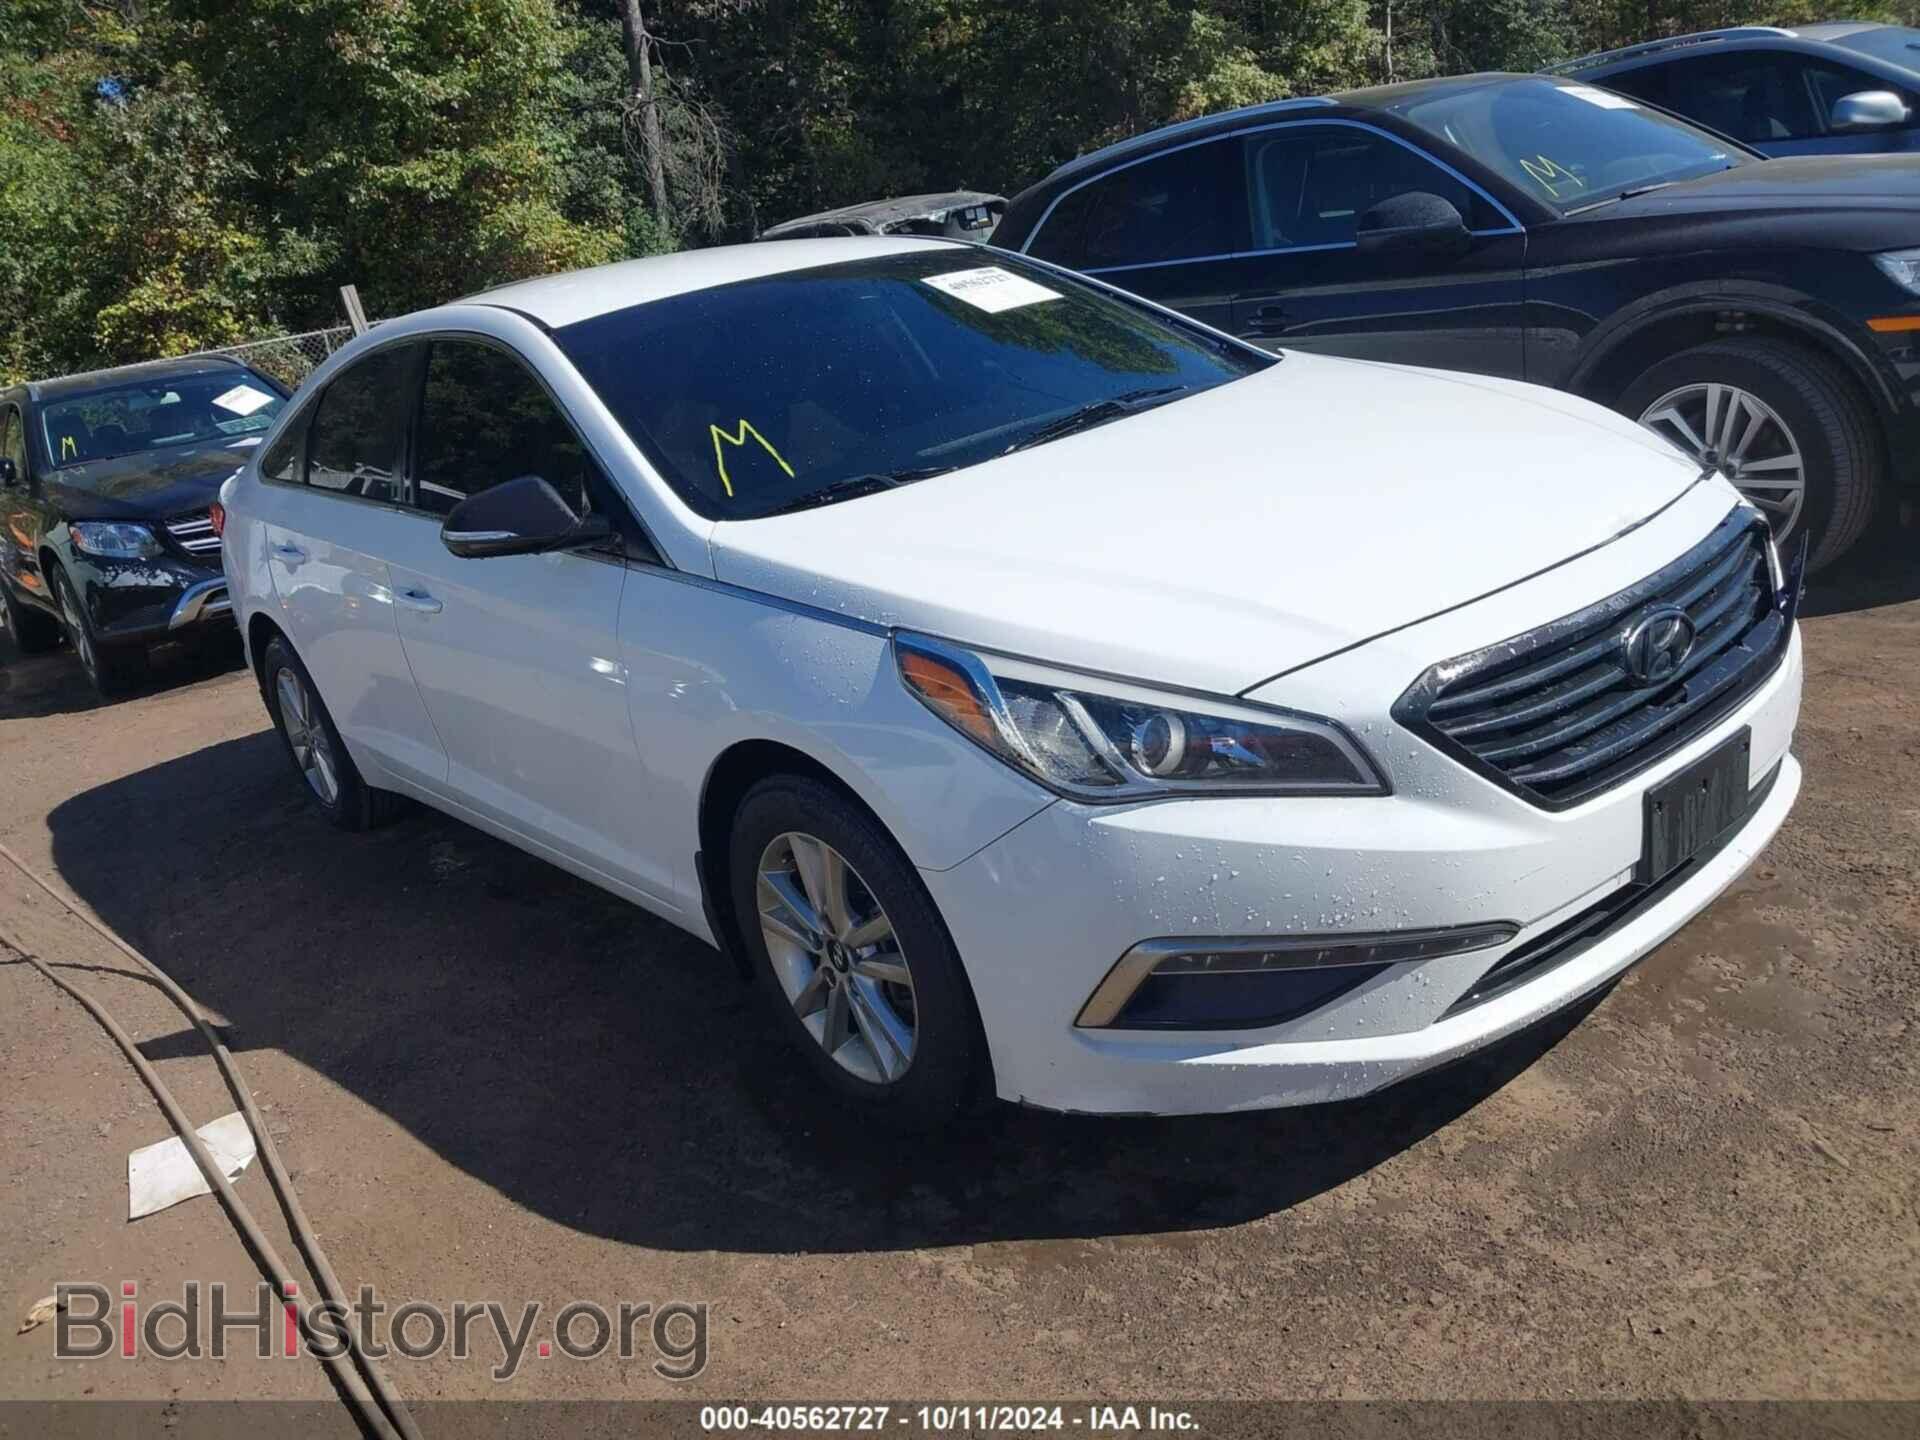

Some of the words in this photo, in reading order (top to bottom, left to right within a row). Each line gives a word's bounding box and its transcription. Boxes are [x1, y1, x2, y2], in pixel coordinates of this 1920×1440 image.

[1519, 154, 1584, 198] M
[61, 434, 78, 462] M
[710, 418, 795, 497] M
